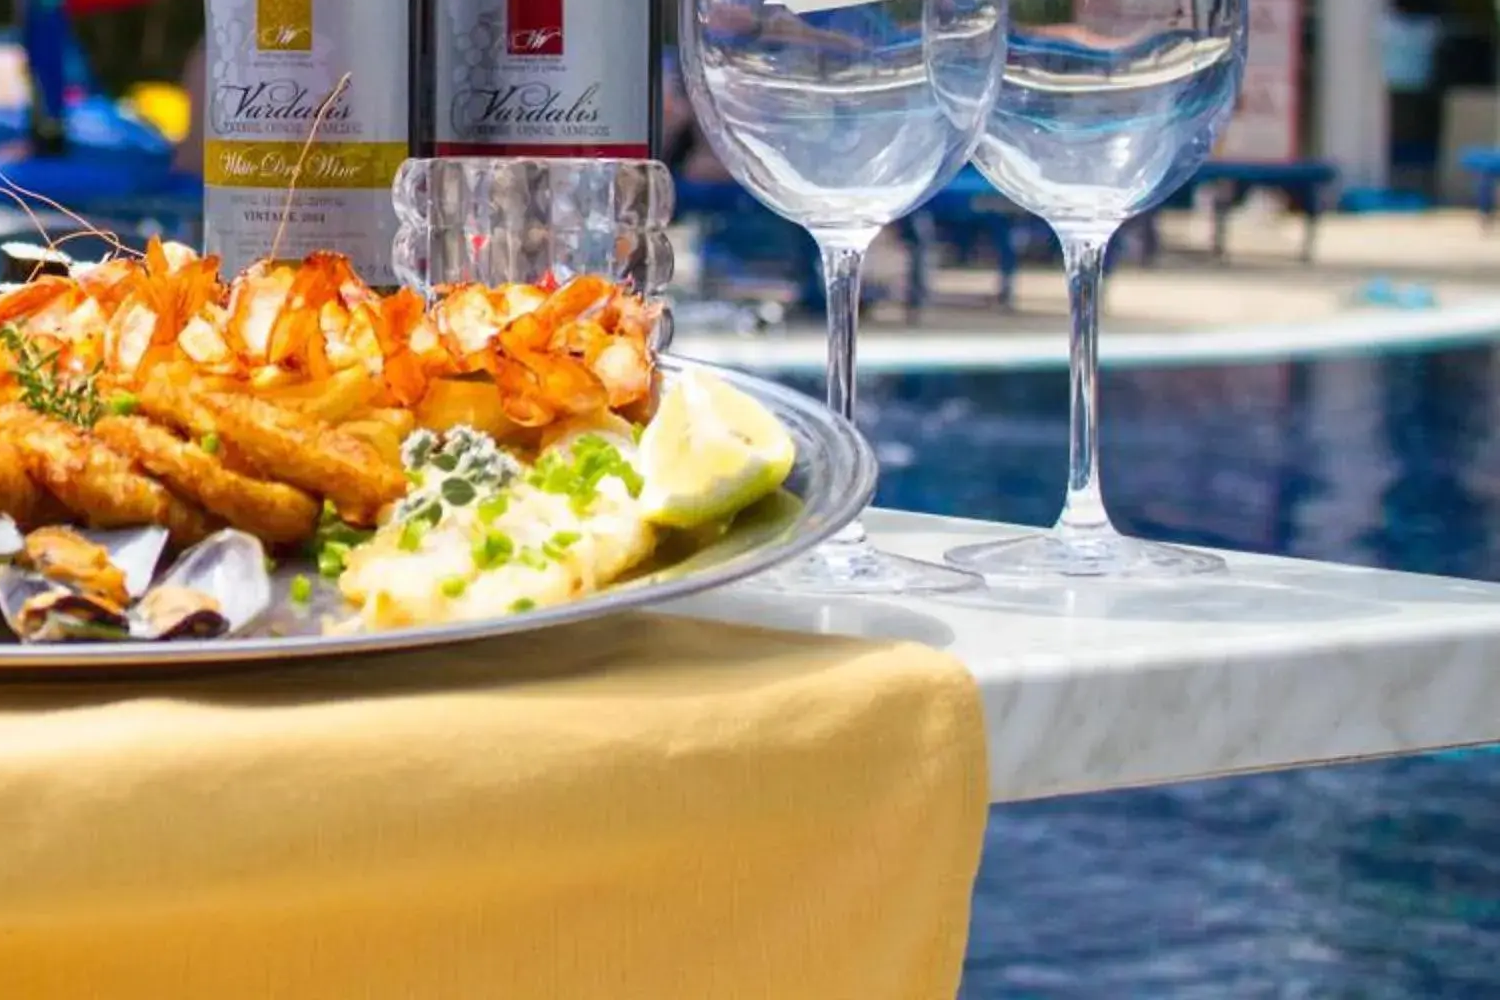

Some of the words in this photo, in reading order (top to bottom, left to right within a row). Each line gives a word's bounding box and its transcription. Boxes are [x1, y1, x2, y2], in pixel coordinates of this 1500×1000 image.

[218, 78, 354, 121] Vardalis
[460, 81, 602, 124] Vardalis
[219, 149, 259, 177] White
[305, 151, 364, 178] Wine
